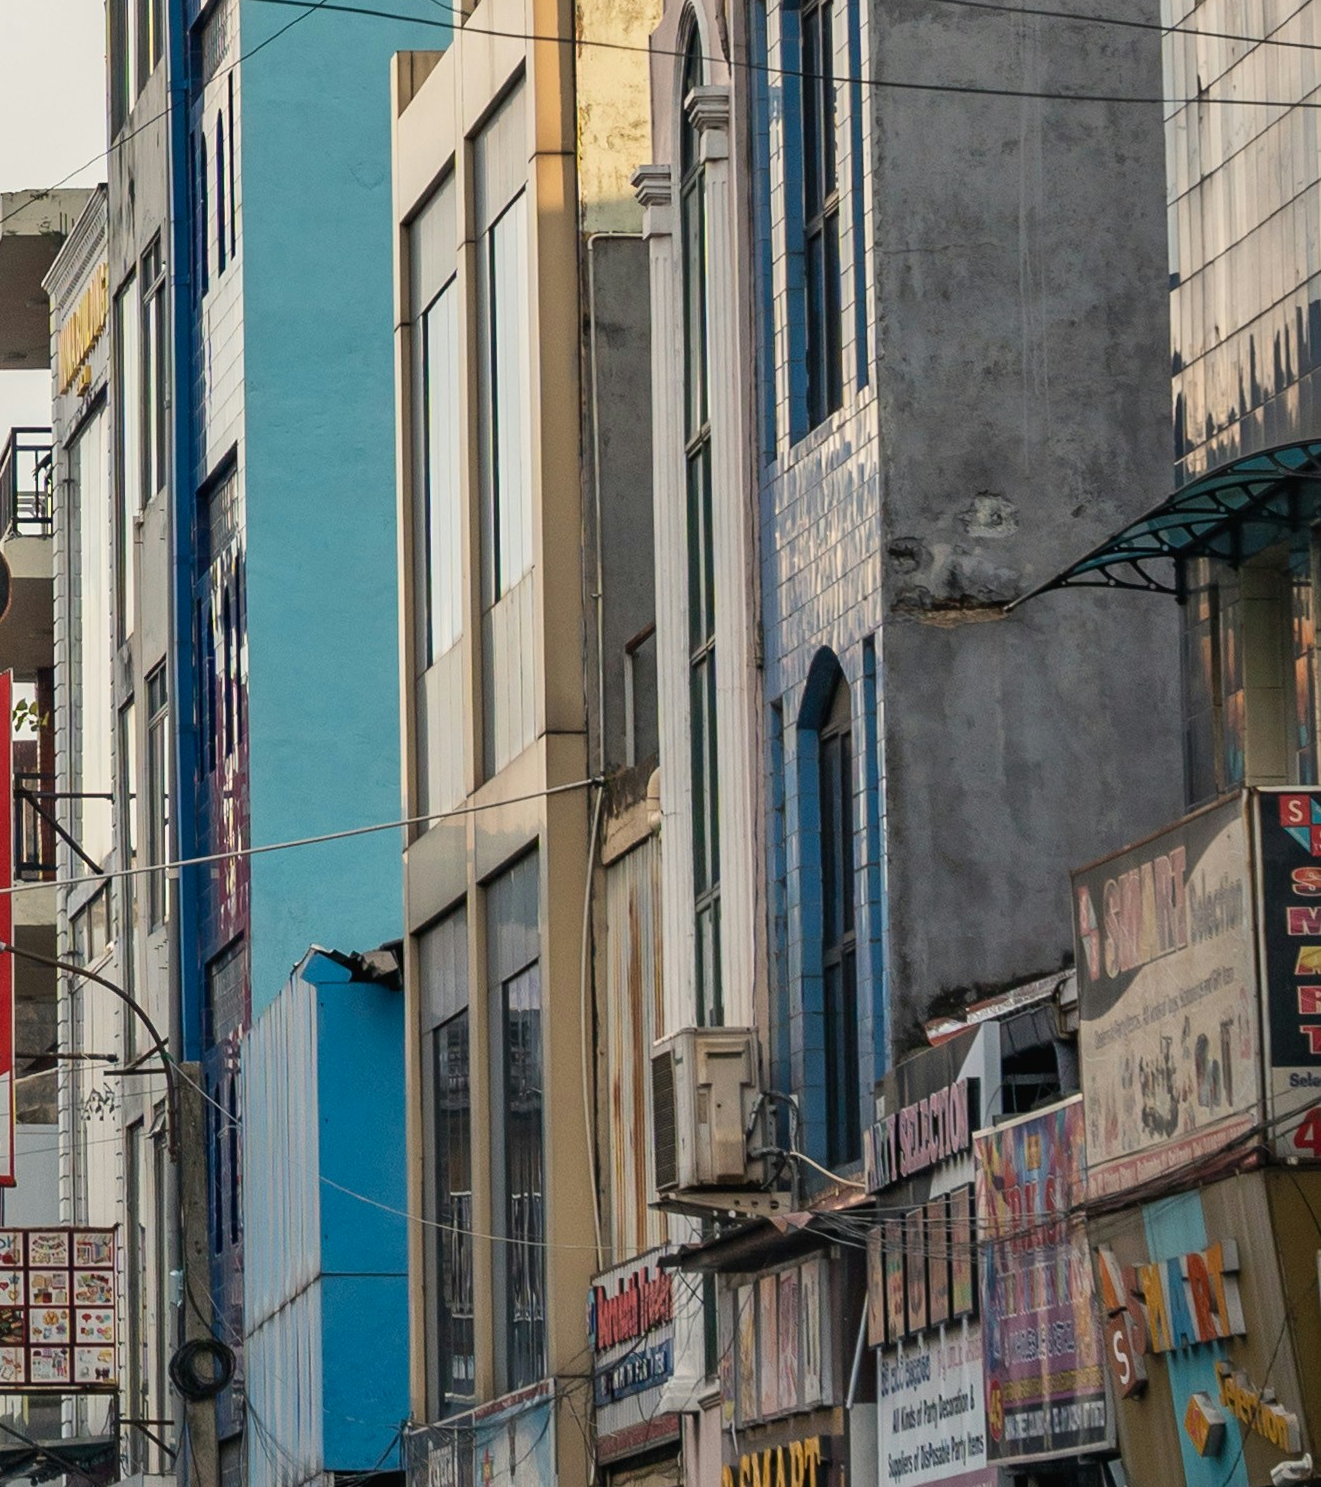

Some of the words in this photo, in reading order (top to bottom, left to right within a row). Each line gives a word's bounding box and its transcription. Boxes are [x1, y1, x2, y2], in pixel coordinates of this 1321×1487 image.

[1103, 846, 1188, 978] SMART
[899, 1078, 969, 1177] SELECTION
[923, 1397, 938, 1429] Party
[939, 1389, 968, 1422] Decoration
[888, 1451, 913, 1485] Suppliers
[951, 1435, 966, 1466] Party
